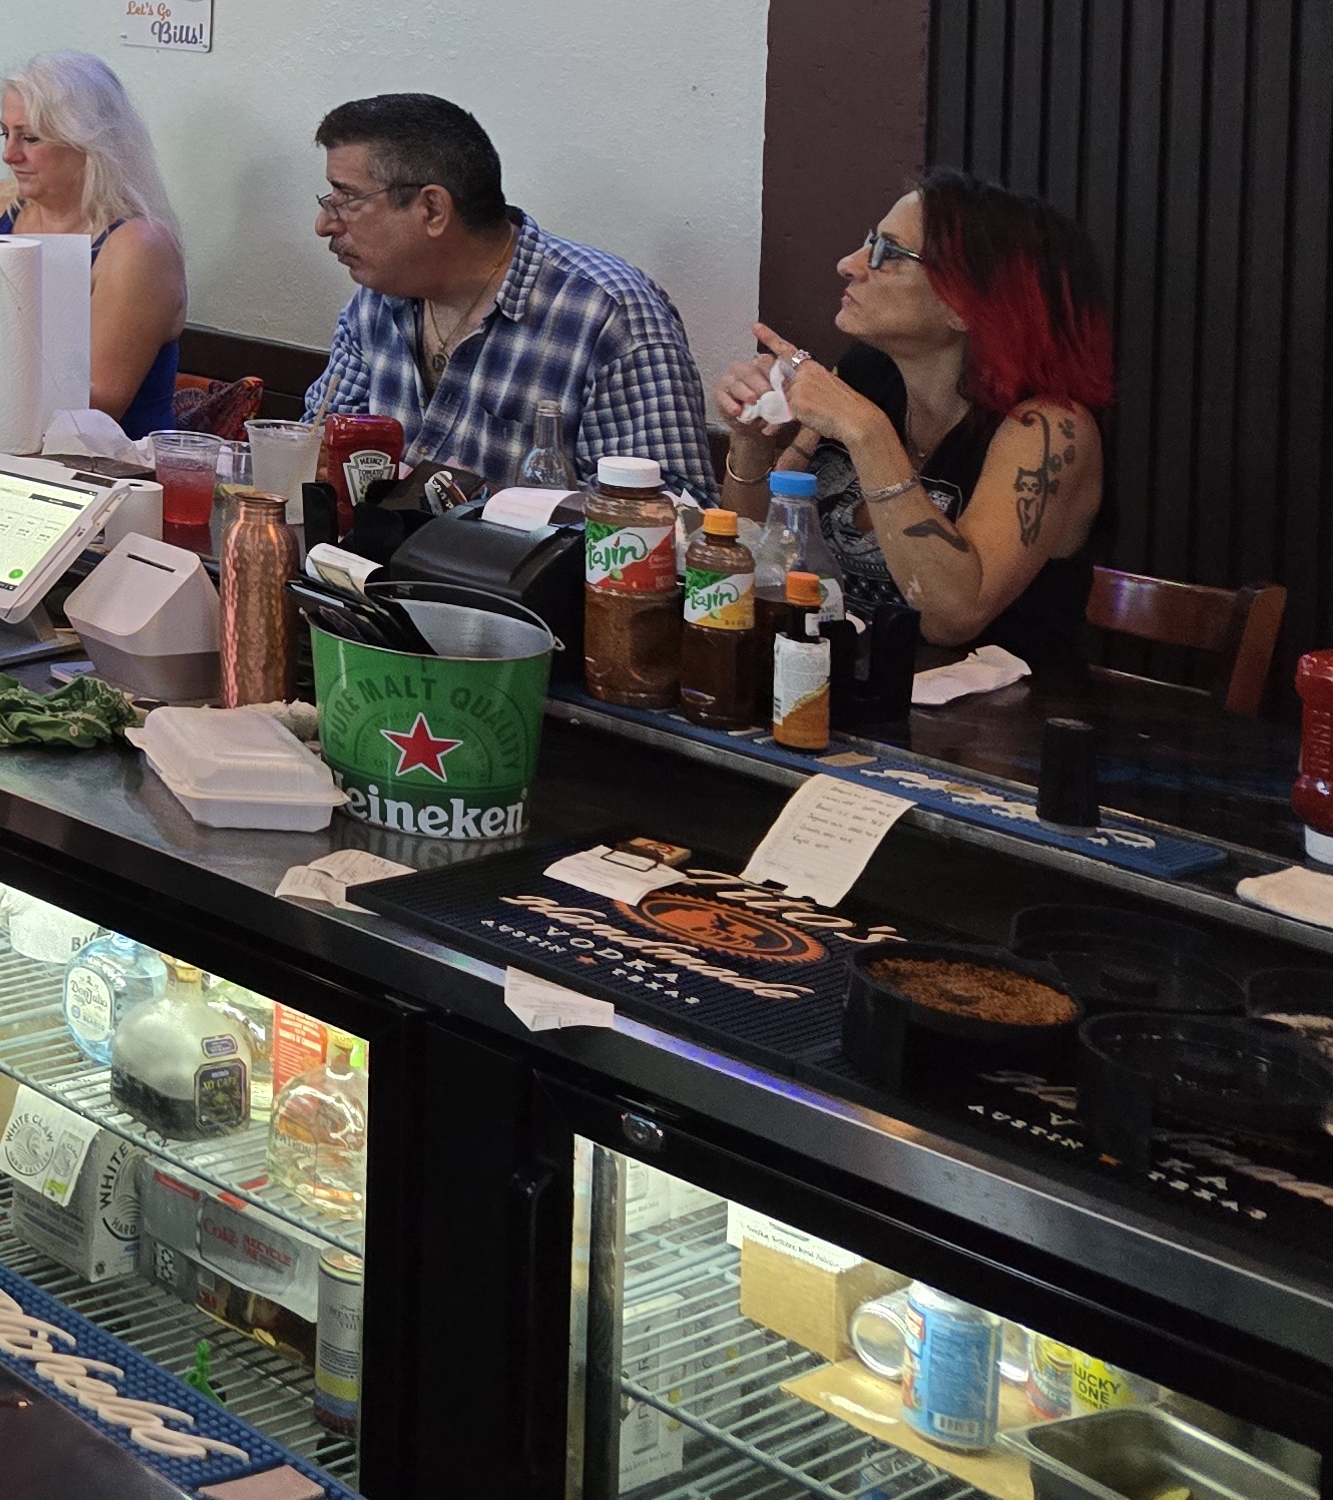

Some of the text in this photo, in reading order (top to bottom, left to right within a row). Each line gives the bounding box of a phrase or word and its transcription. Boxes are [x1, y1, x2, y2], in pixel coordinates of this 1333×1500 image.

[126, 1, 171, 21] Let's Go
[151, 21, 204, 45] Bills!
[358, 469, 384, 477] TOMATO
[359, 456, 383, 466] HEINZ
[332, 675, 520, 770] PURE MALT QUALITY
[481, 918, 701, 1005] AUSTIN TEXAS
[545, 925, 680, 985] VODKA
[6, 1113, 55, 1143] WHITE CLAW
[967, 1104, 1084, 1150] AUSTIN
[8, 1150, 23, 1172] HARD
[99, 1141, 128, 1211] WHITE
[1147, 1169, 1268, 1221] TEXAS
[111, 1217, 137, 1236] HARD
[203, 1218, 239, 1248] Coke
[243, 1234, 293, 1267] RECYCLE
[1073, 1363, 1121, 1395] LUCKY
[1078, 1382, 1110, 1405] ONE
